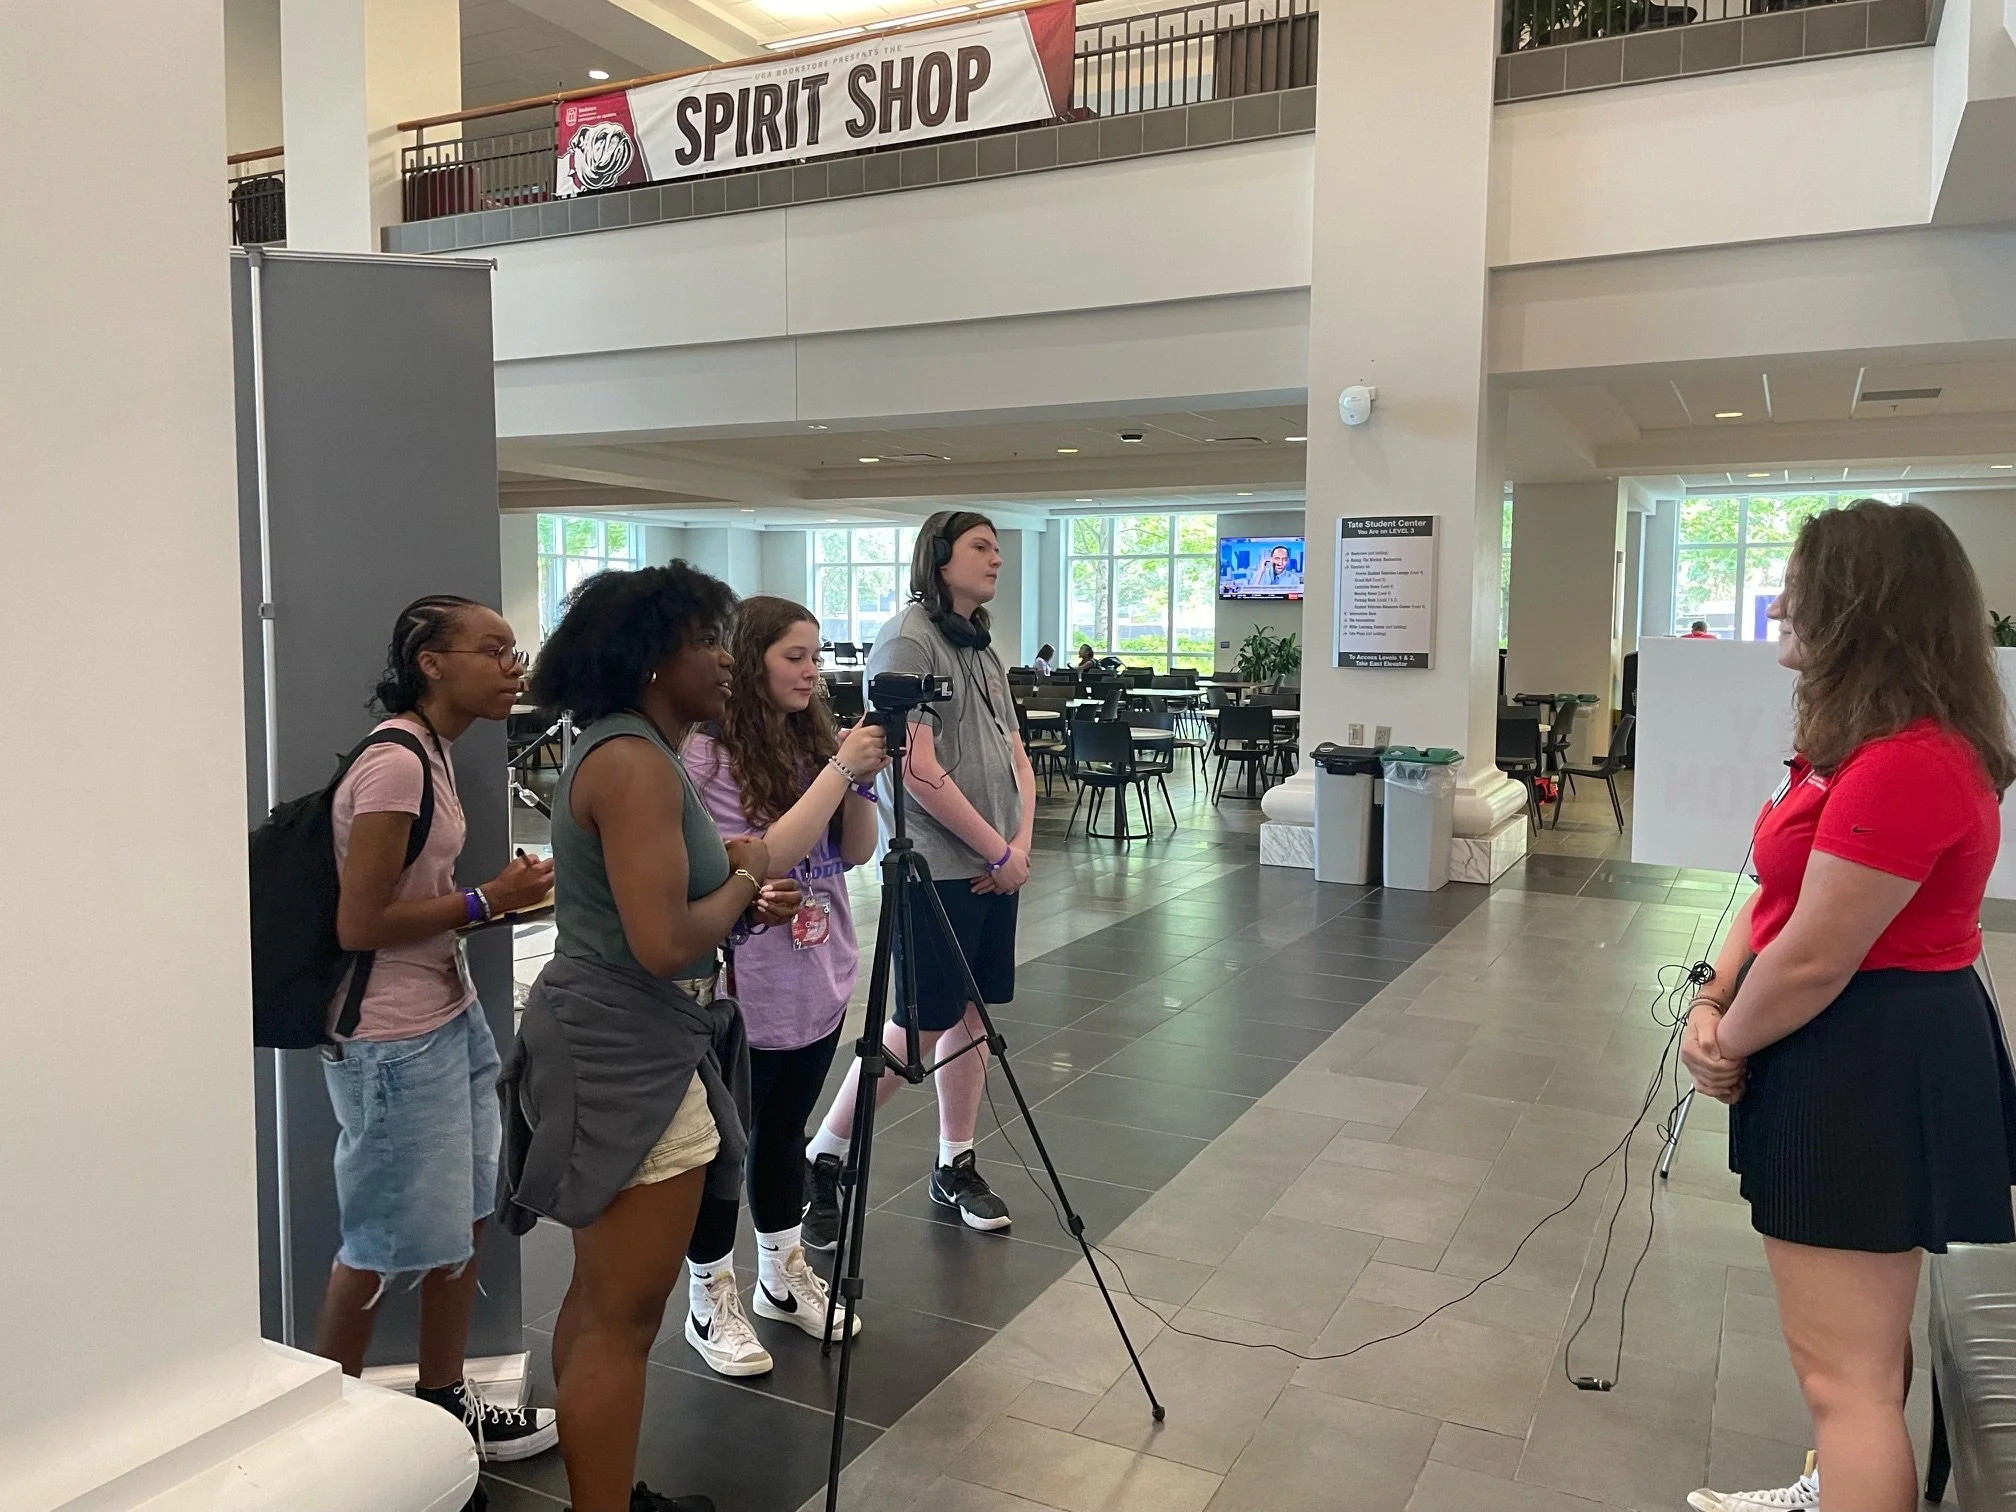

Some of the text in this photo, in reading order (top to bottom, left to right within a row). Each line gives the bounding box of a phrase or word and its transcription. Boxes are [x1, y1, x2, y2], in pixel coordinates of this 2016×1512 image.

[755, 45, 902, 80] UGA BOOKSTORE PRESENTS THE
[675, 45, 991, 166] SPIRIT SHOP
[1365, 520, 1396, 528] Student
